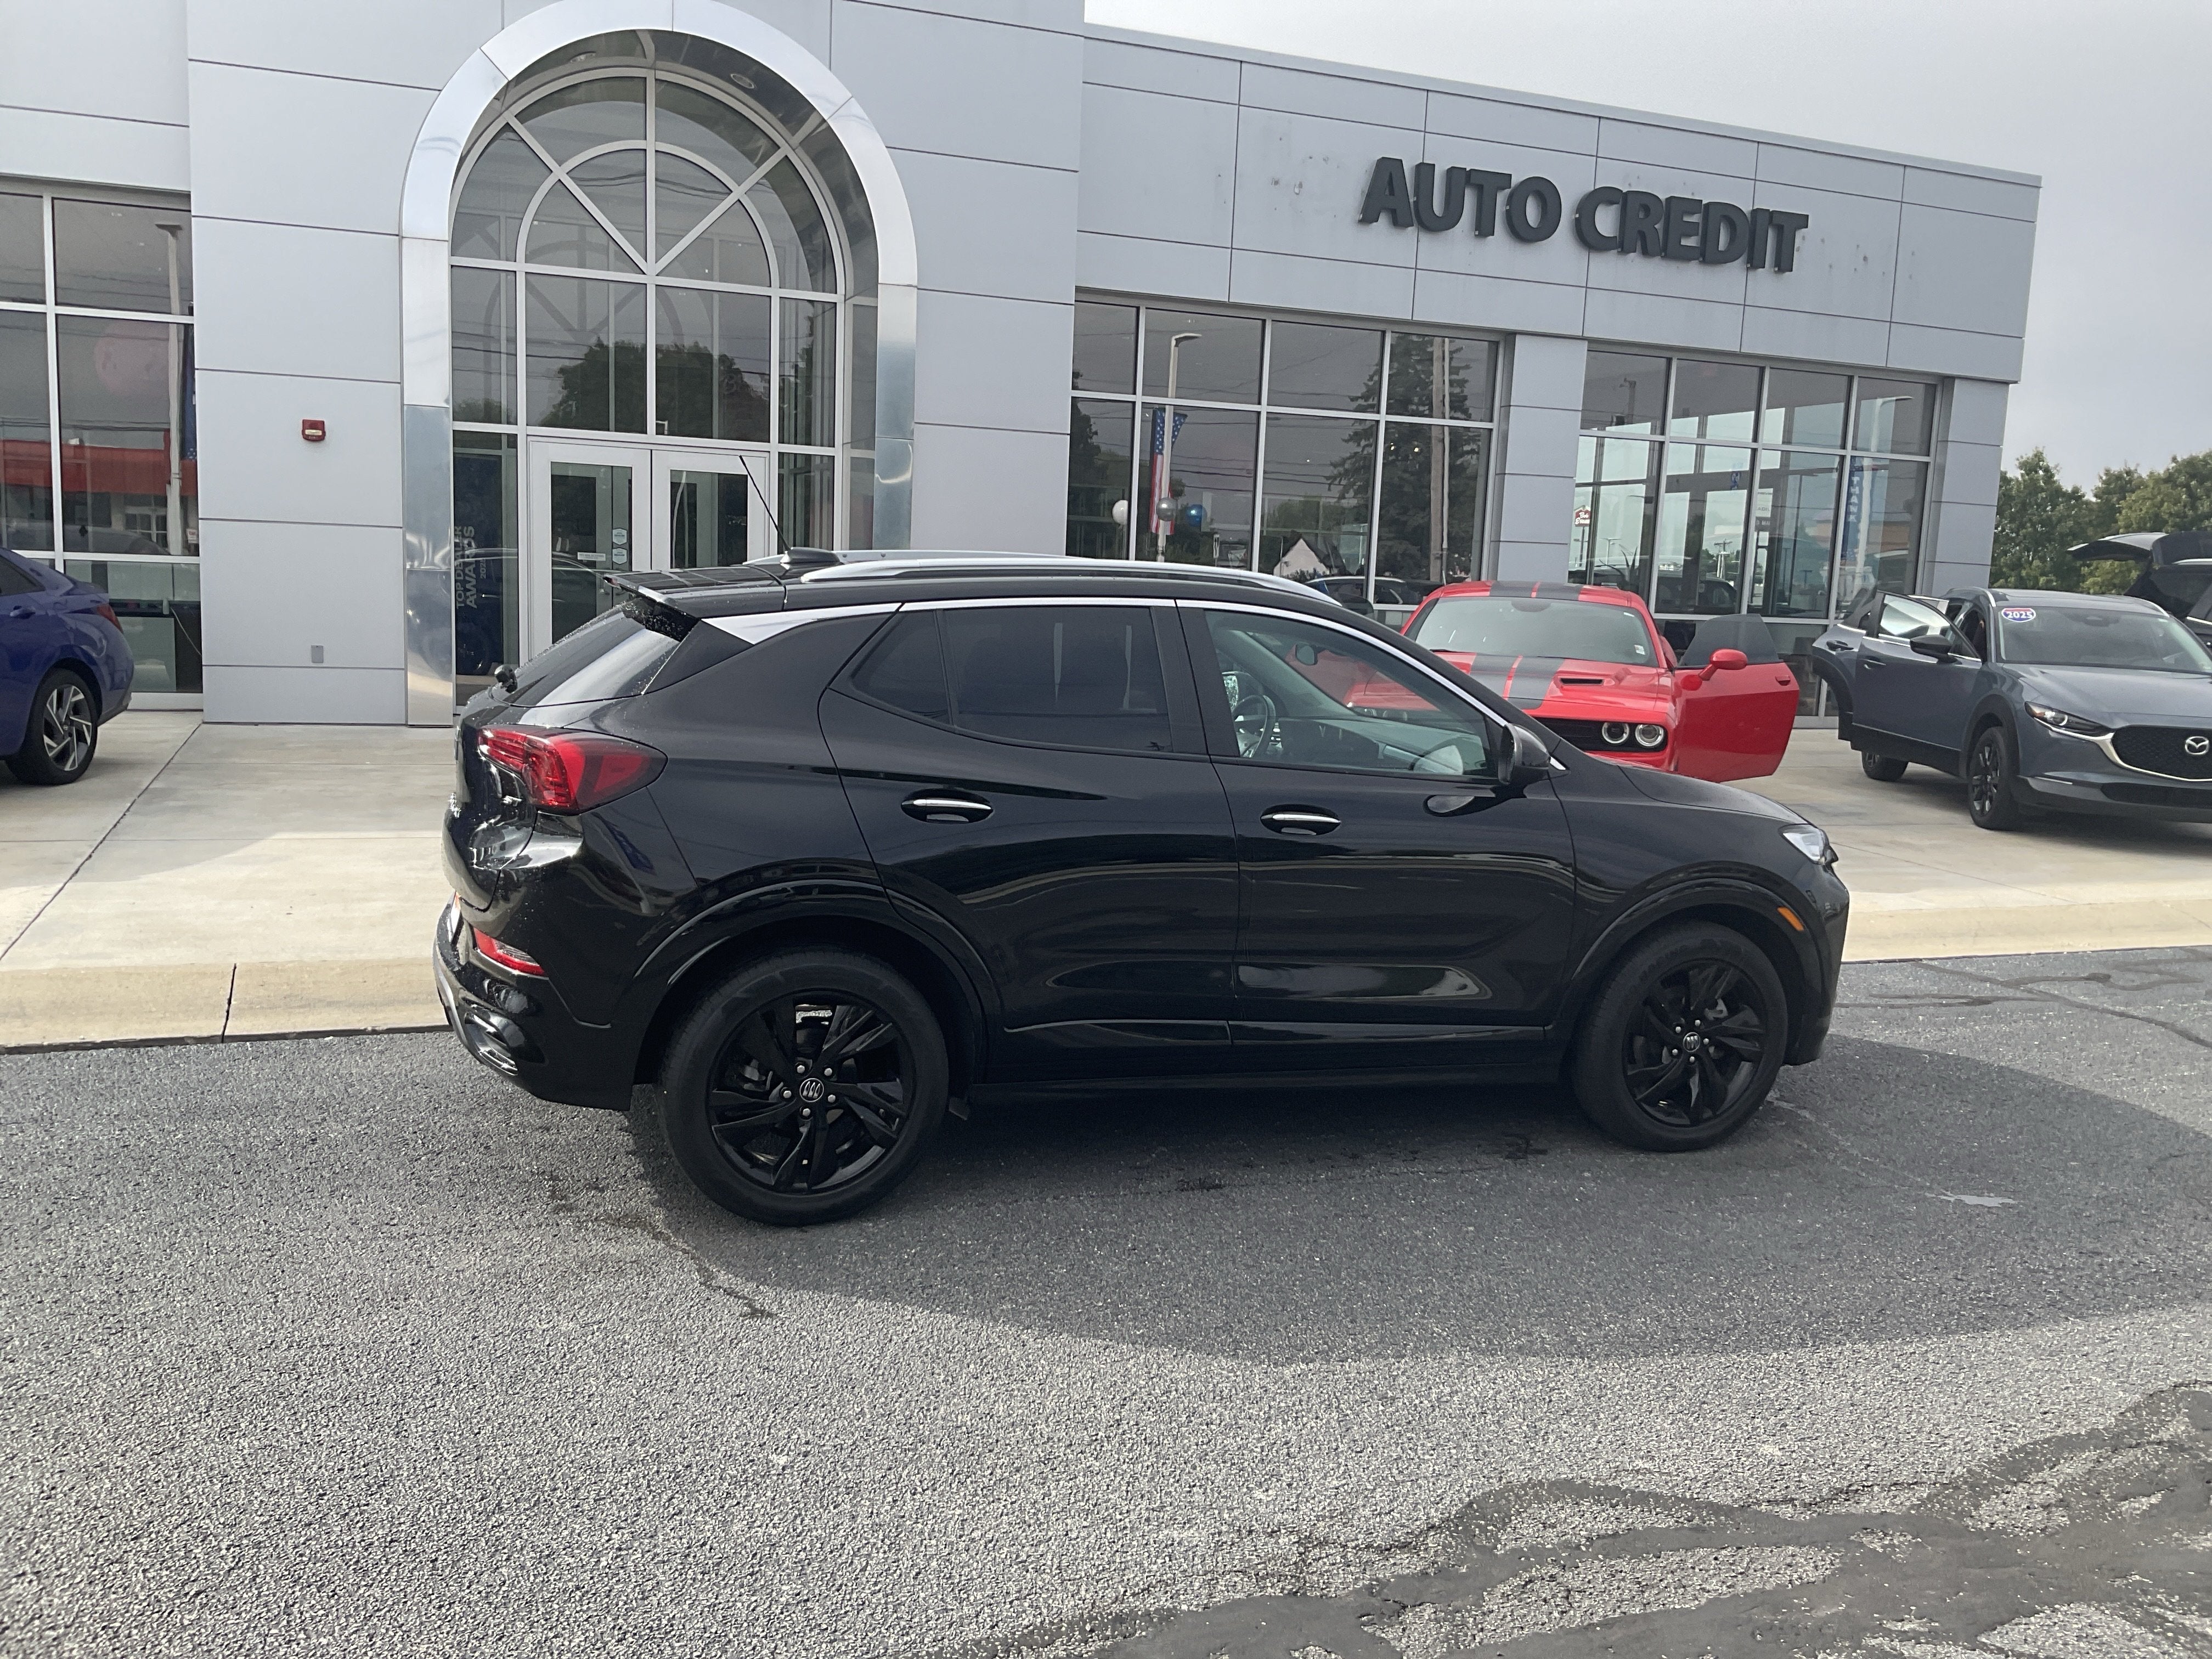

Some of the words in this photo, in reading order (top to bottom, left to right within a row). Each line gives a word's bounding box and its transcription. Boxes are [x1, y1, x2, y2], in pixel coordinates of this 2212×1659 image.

[1358, 156, 1562, 243] AUTO
[1575, 186, 1809, 273] CREDIT
[1848, 476, 1860, 522] THANK
[454, 526, 464, 580] DEALER
[463, 526, 477, 609] AWARDS
[455, 582, 465, 610] TOP
